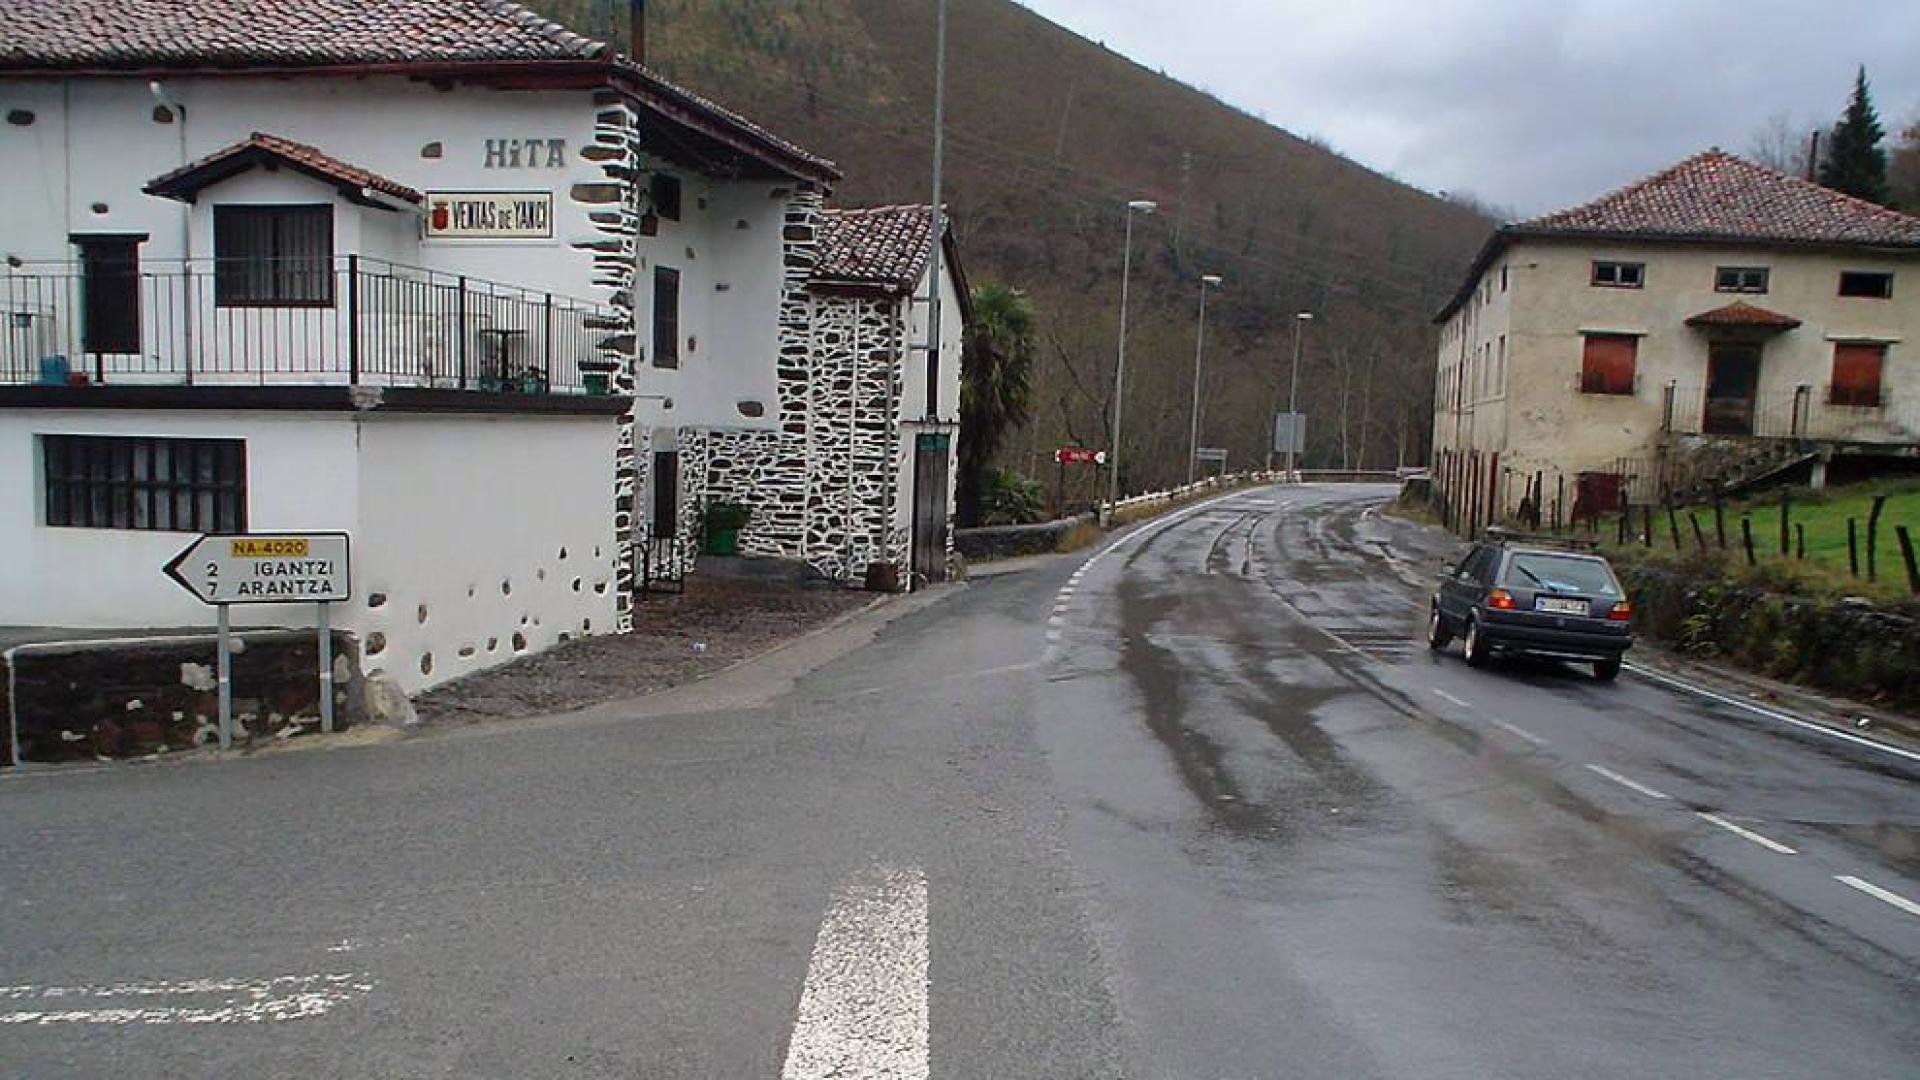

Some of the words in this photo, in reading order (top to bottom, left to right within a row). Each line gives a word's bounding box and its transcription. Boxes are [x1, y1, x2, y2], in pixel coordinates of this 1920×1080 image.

[453, 201, 496, 229] VENTAS
[233, 541, 307, 554] NA-4020
[206, 562, 218, 577] 2
[254, 561, 334, 576] IGANTZI
[207, 582, 218, 596] 7
[238, 581, 333, 596] ARANTZA
